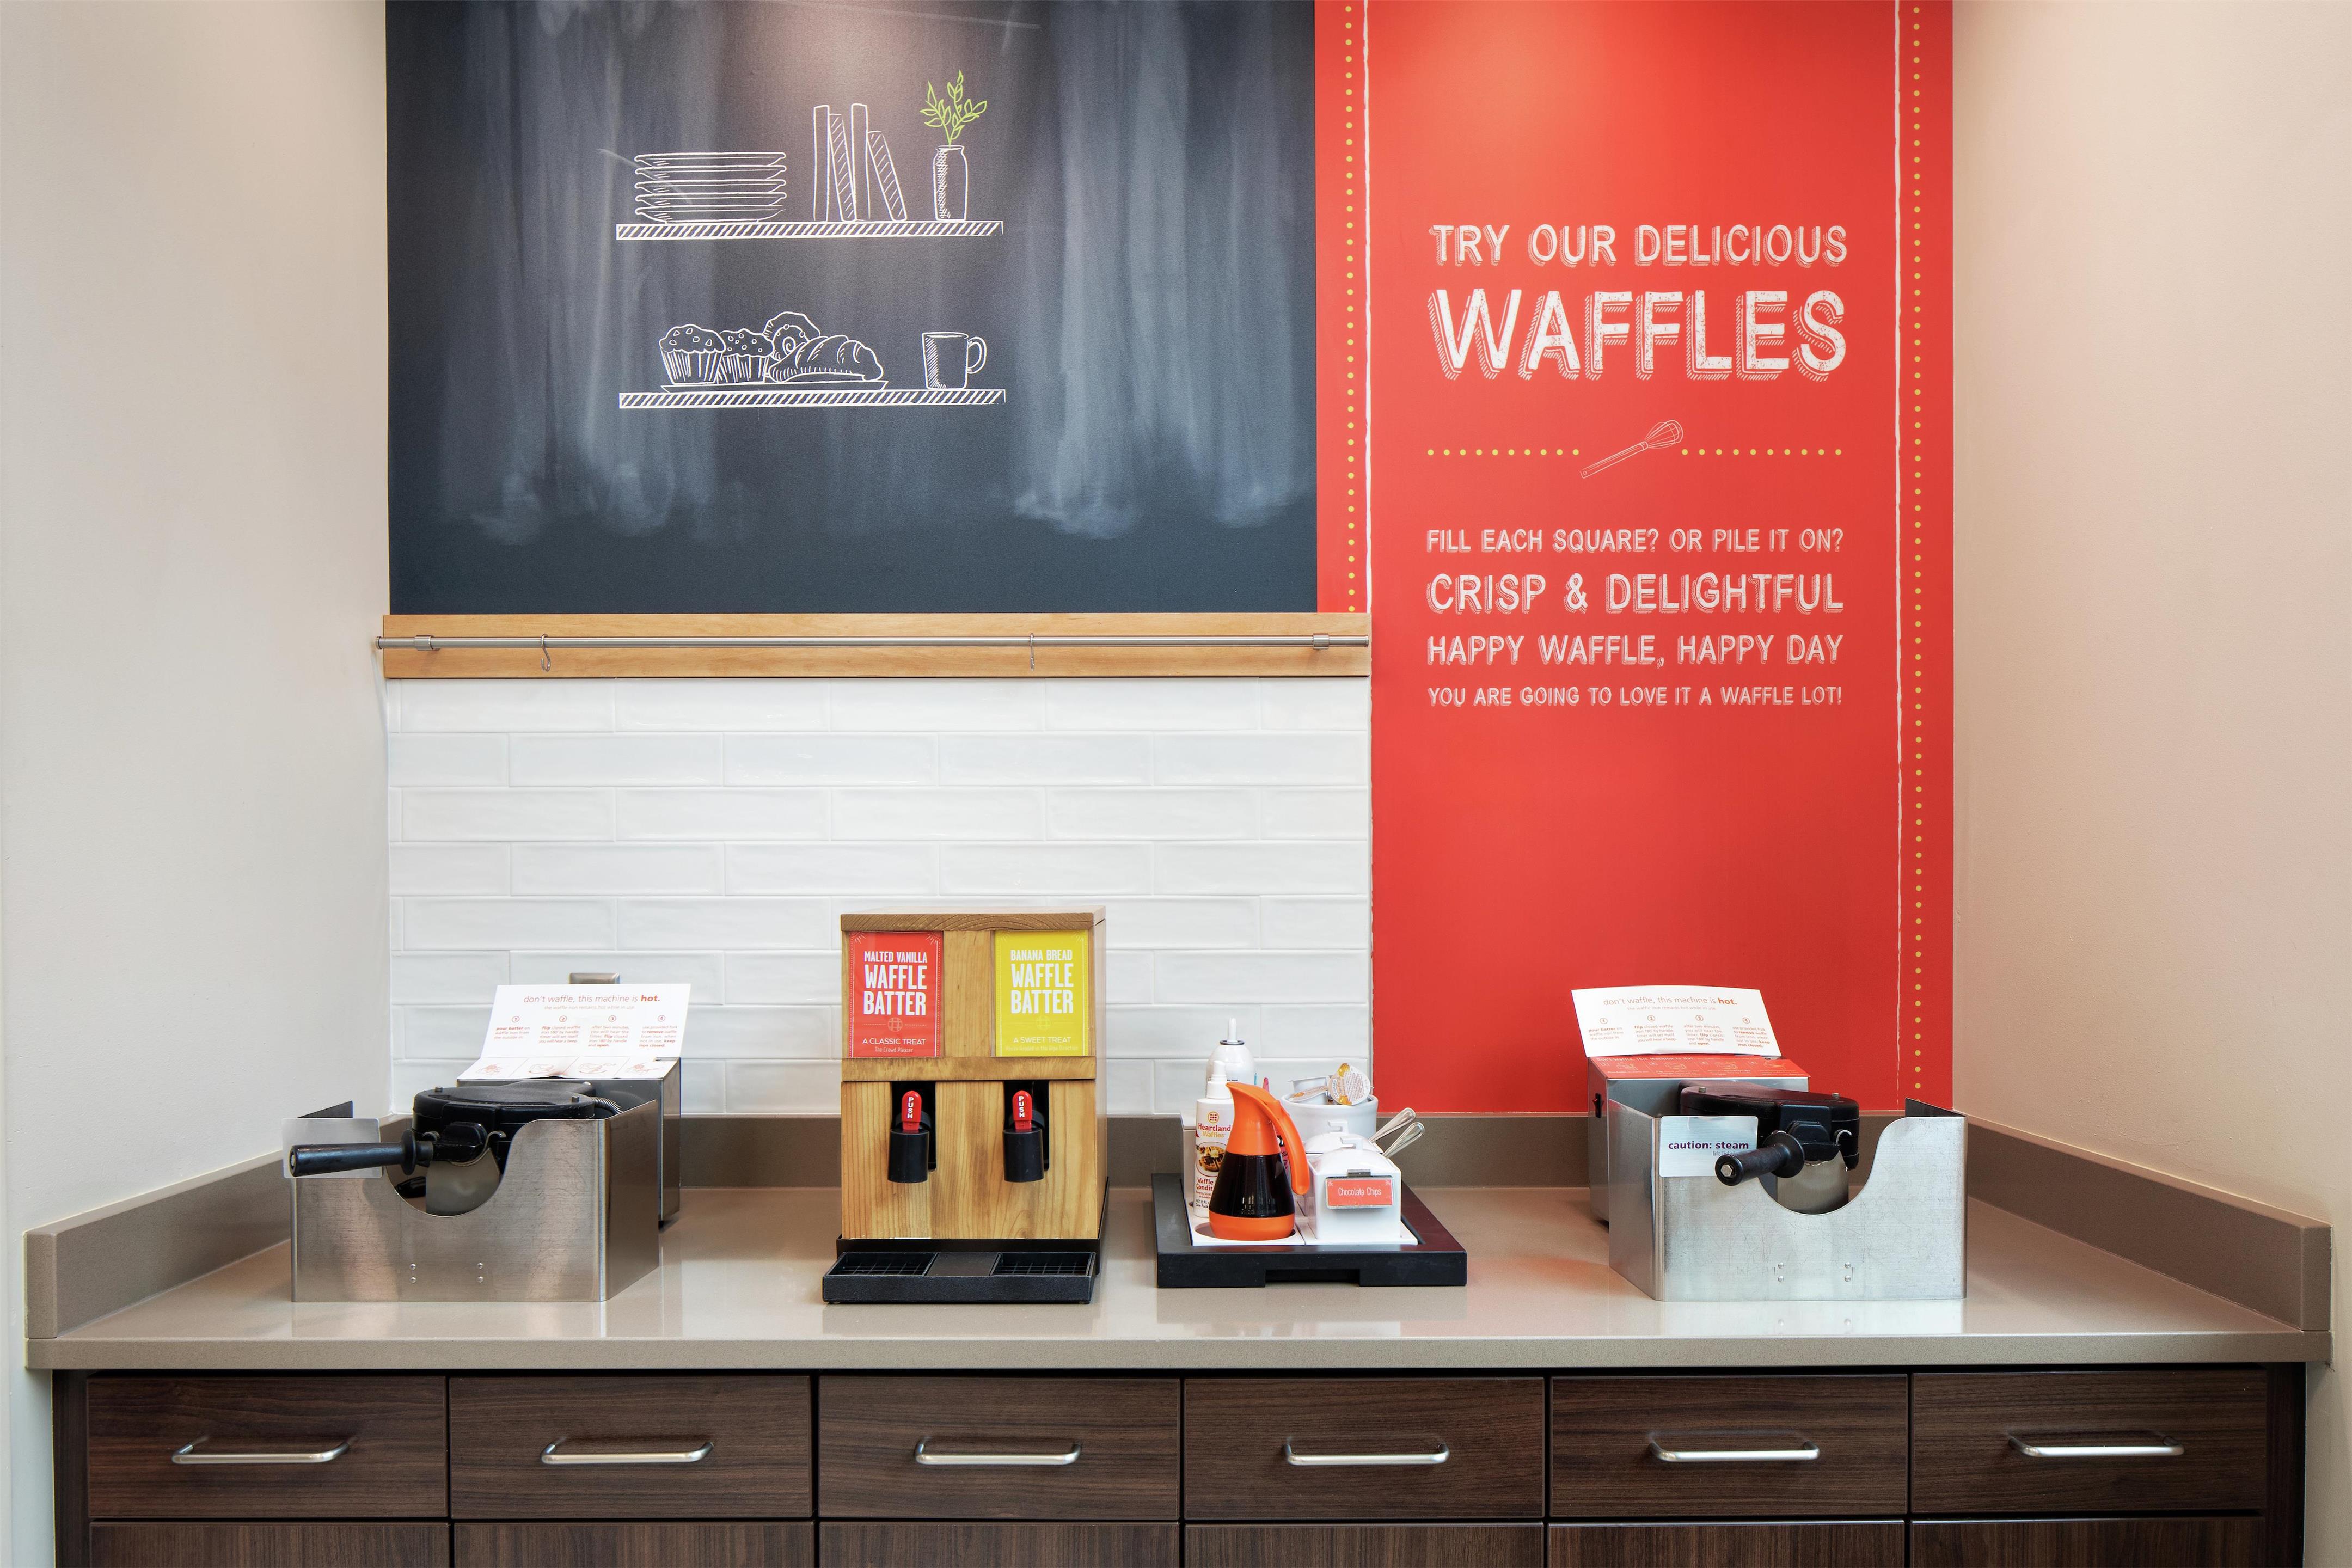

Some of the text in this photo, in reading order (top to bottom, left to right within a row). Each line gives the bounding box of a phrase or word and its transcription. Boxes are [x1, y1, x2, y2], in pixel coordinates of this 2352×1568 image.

[1429, 224, 1847, 266] TRY OUR DELICIOUS
[1427, 289, 1846, 381] WAFFLES
[1427, 529, 1843, 552] FILL EACH SQUARE? OR PILE IT ON?
[1427, 573, 1843, 615] CRISP & DELIGHTFUL
[1427, 635, 1843, 669] HAPPY WAFFLE, HAPPY DAY
[1427, 687, 1842, 707] YOU ARE GOING TO LOVE IT A WAFFLE LOT!
[865, 951, 927, 963] MALTED VANILLA
[1010, 950, 1072, 961] BANANA BREAD
[865, 965, 927, 989] WAFFLE
[1011, 963, 1074, 987] WAFFLE
[863, 991, 926, 1015] BATTER
[1011, 990, 1074, 1014] BATTER
[1198, 1123, 1231, 1131] Heartland
[1338, 1187, 1381, 1197] Chocolate Chips
